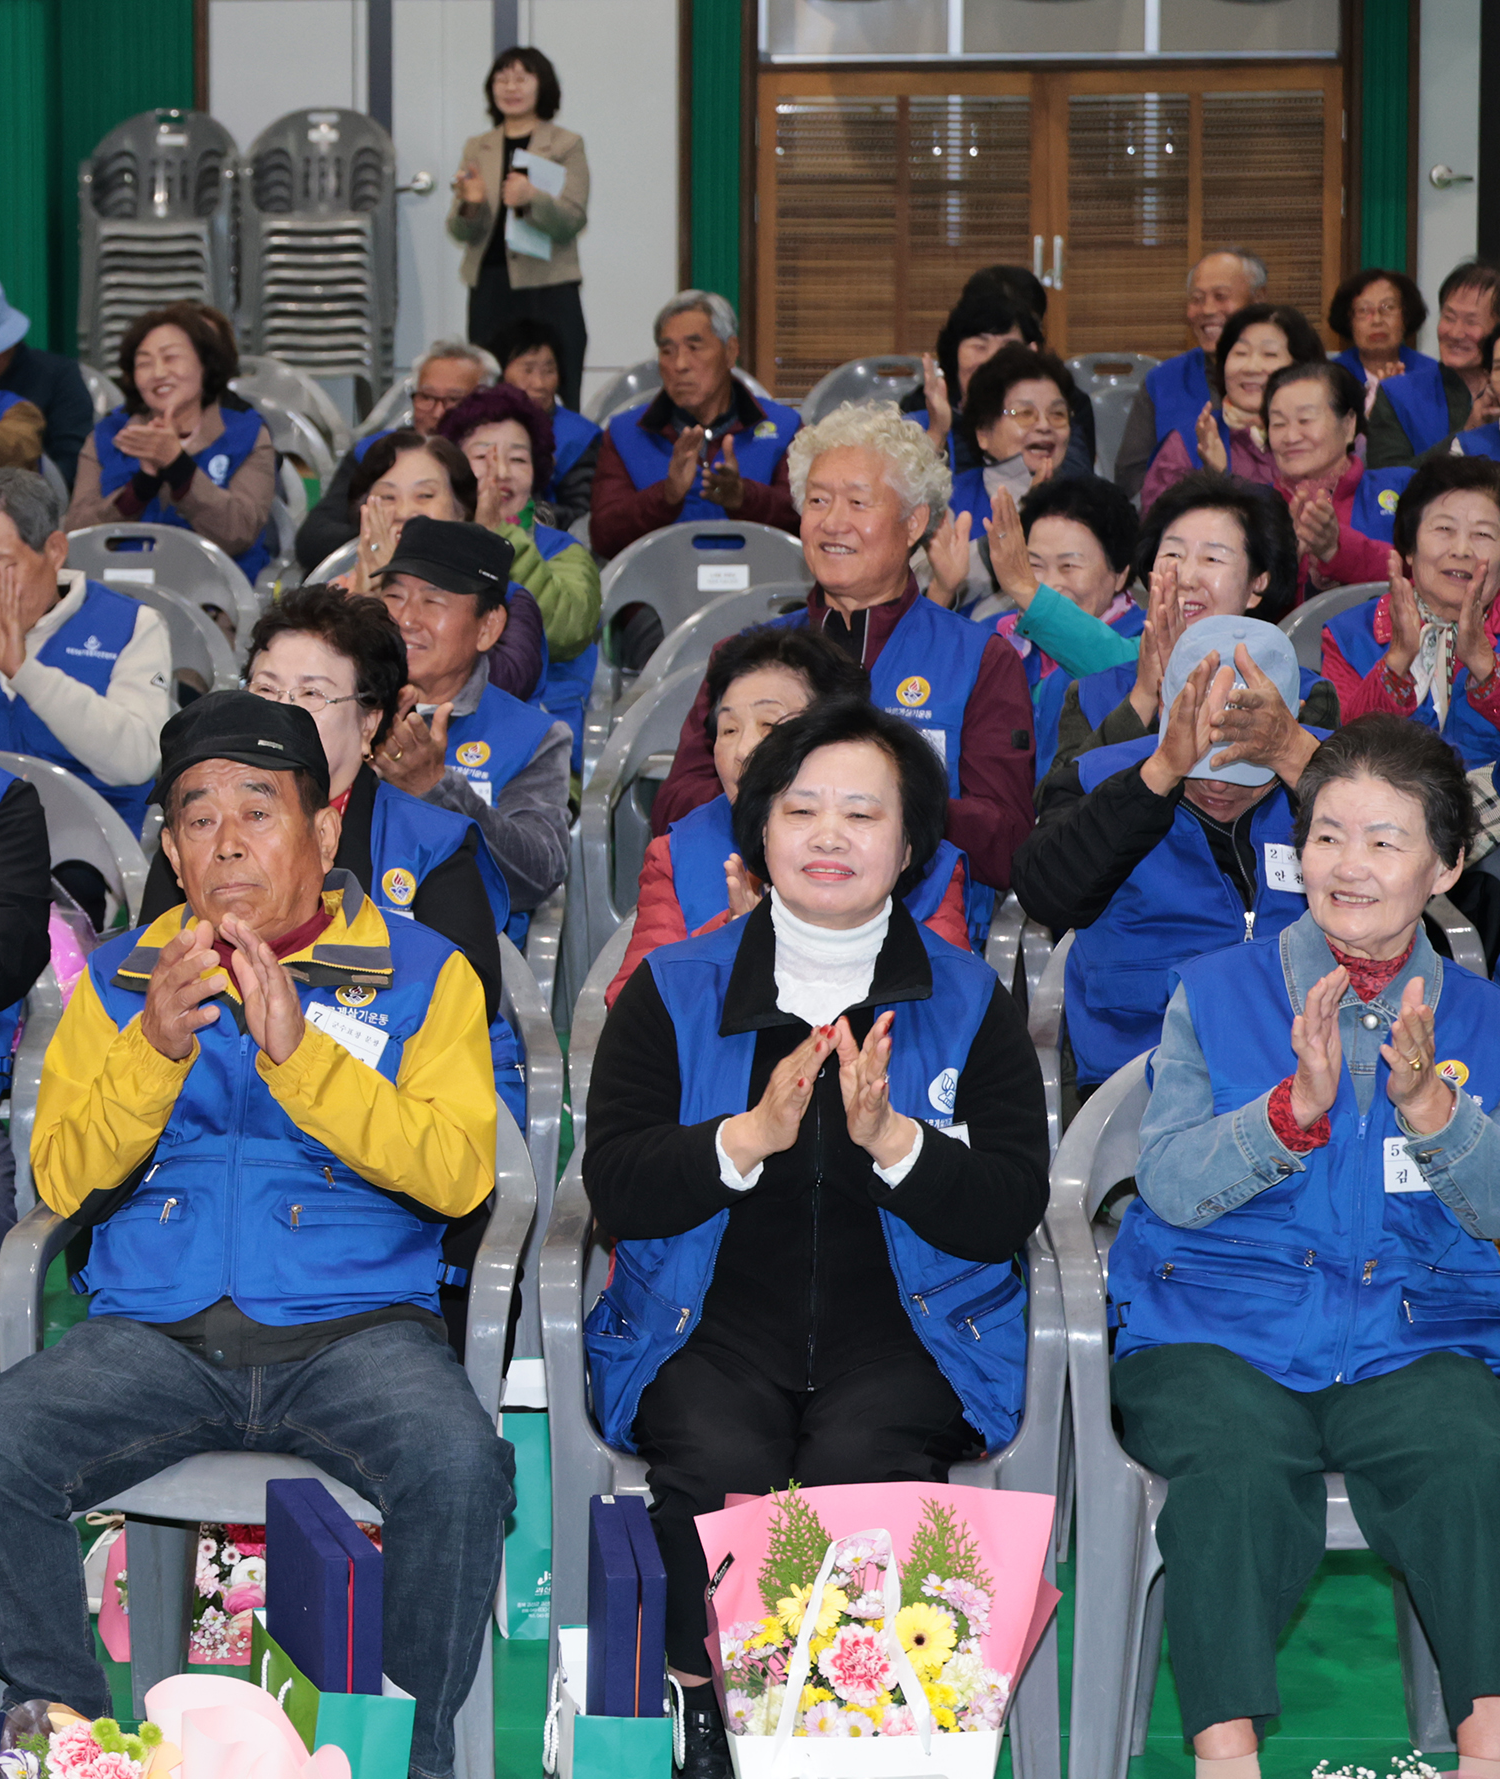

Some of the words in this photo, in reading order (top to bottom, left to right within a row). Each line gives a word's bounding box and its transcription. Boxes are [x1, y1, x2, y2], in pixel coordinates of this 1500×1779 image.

[1269, 848, 1278, 859] 2
[313, 1011, 324, 1023] 7
[1390, 1143, 1400, 1157] 5
